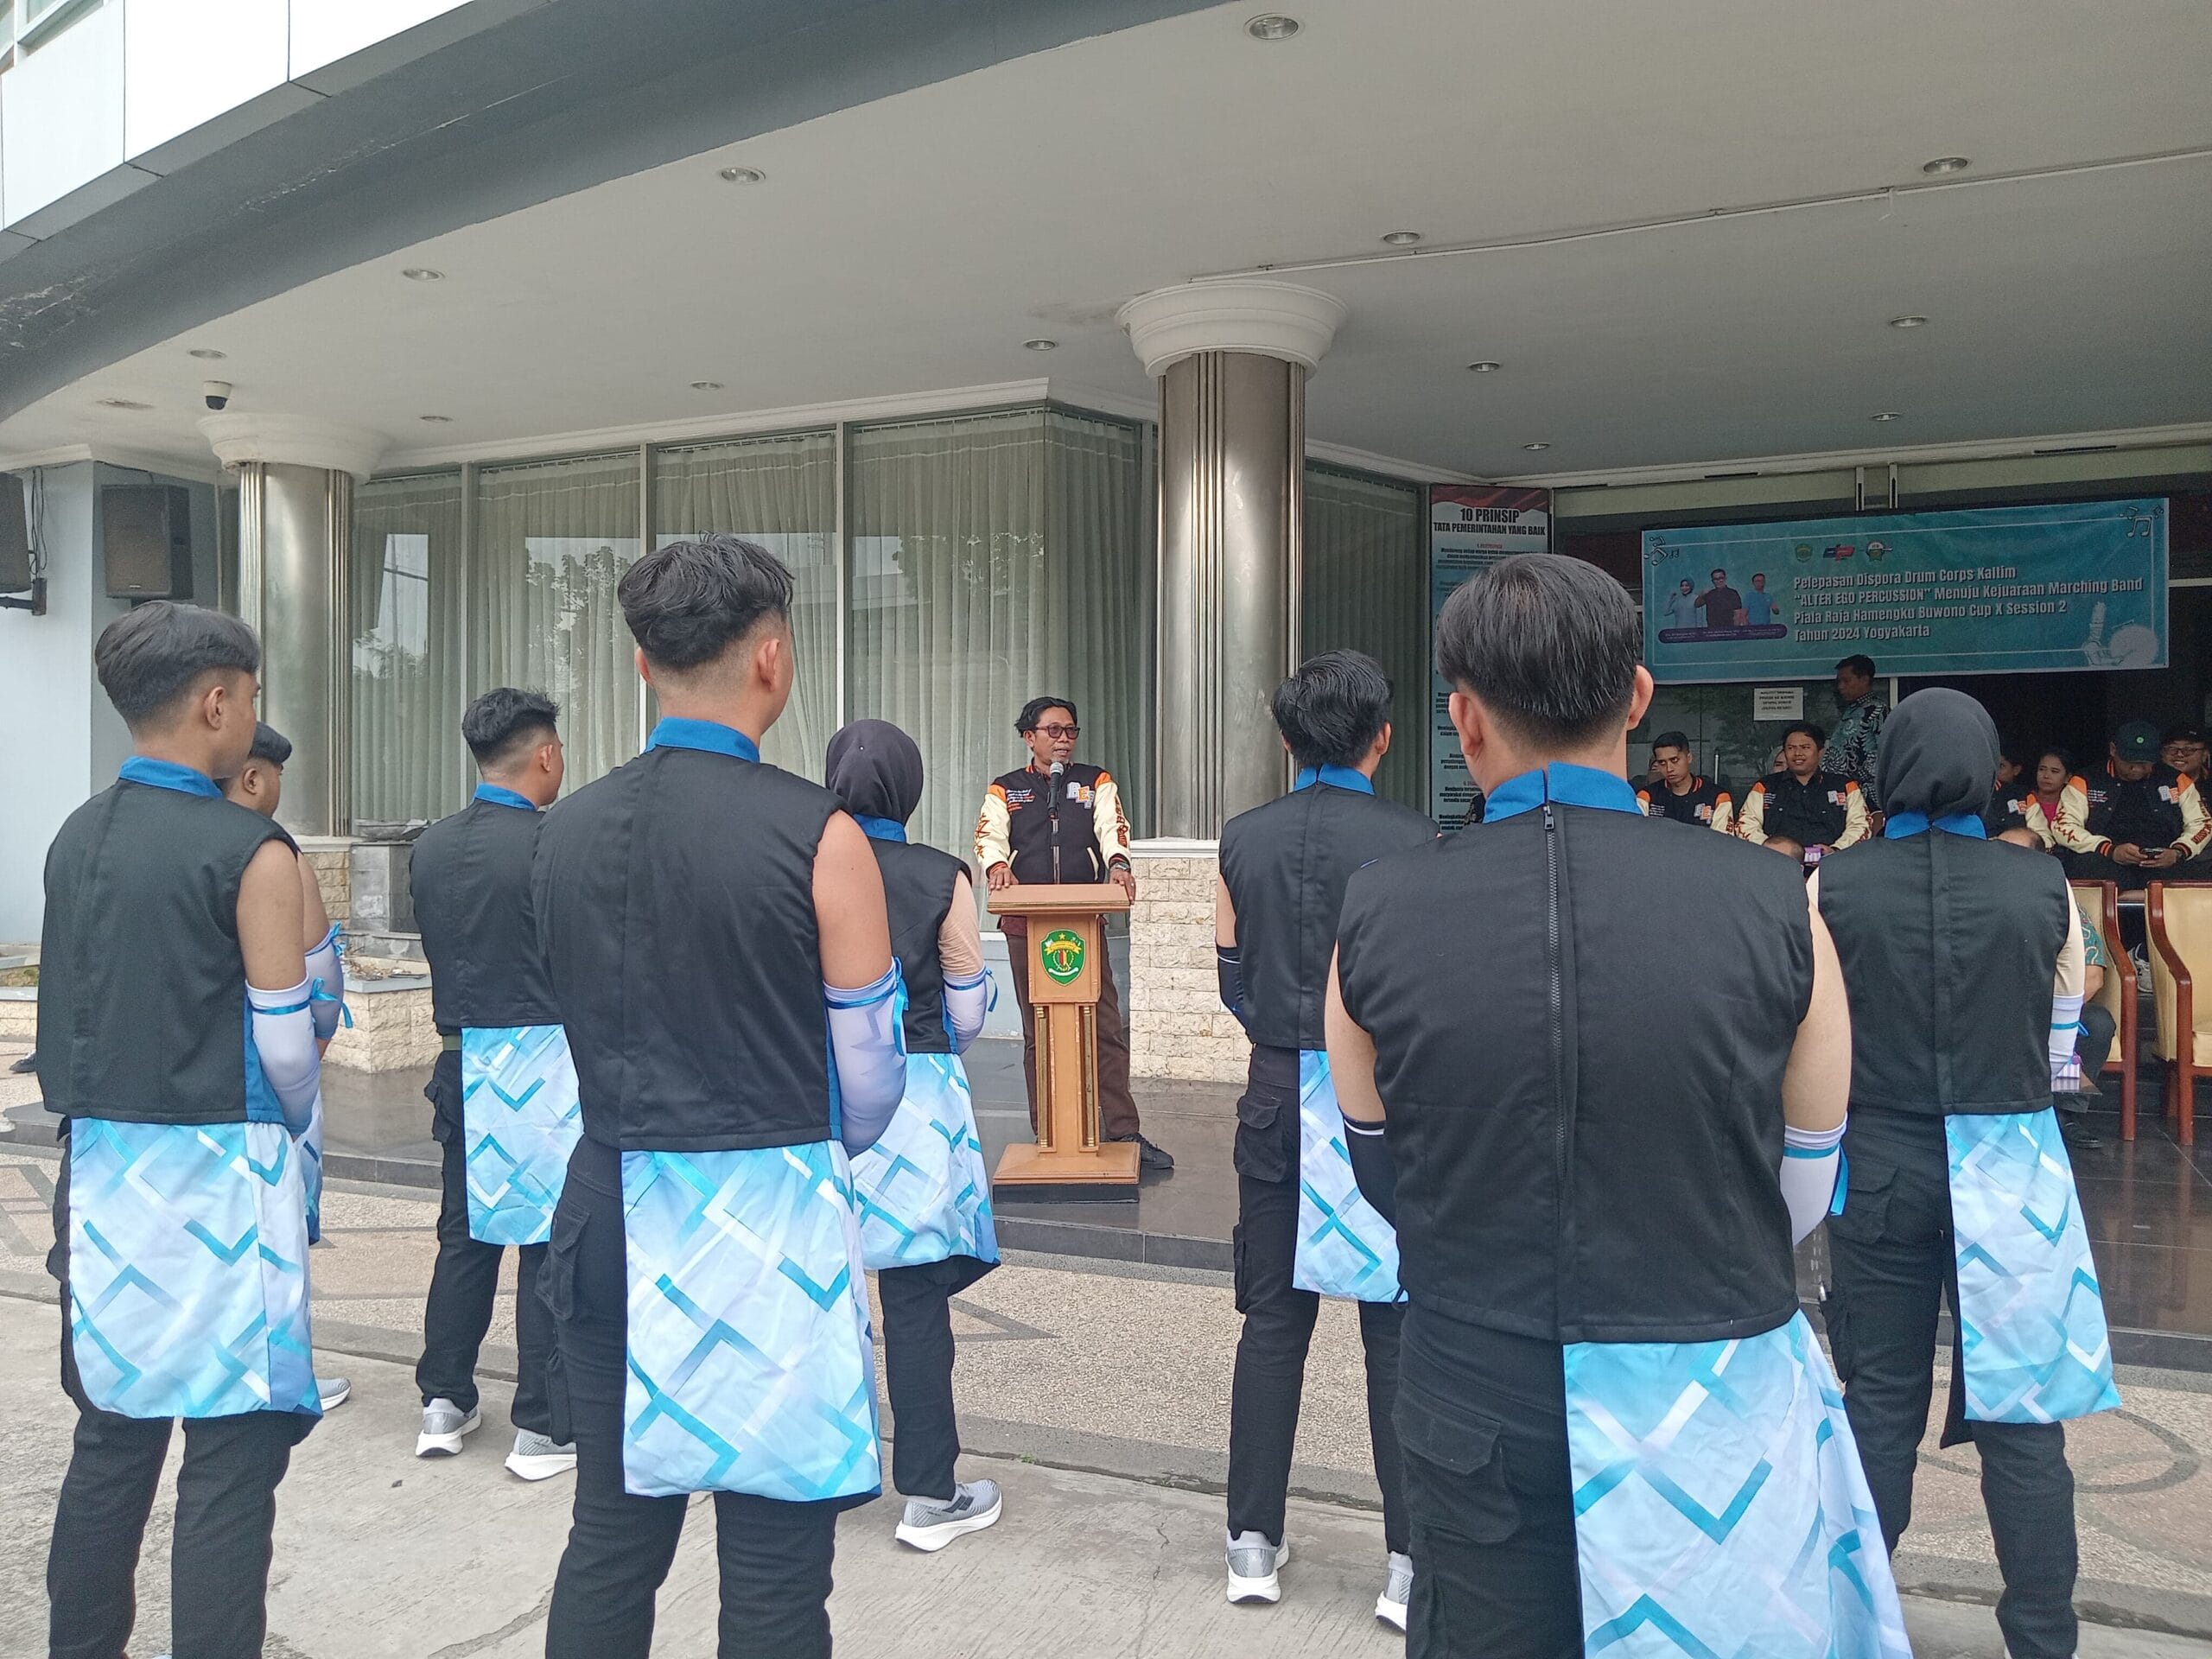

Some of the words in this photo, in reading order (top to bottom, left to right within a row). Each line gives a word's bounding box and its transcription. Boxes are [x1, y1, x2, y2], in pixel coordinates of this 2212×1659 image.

[1460, 508, 1473, 521] 10
[1476, 508, 1519, 524] PRINSIP
[1433, 522, 1451, 532] TATA
[1452, 523, 1507, 534] PEMERINTAHAN
[1508, 524, 1527, 535] YANG
[1528, 525, 1546, 536] BAIK
[1794, 575, 1853, 590] Pelepasan
[1858, 572, 1901, 588] Dispora
[1905, 570, 1936, 584] Drum
[1940, 568, 1974, 582] Corps
[1977, 565, 2017, 580] Kaltim
[1835, 591, 1855, 605] EGO
[1935, 585, 1980, 600] Menuju
[1983, 583, 2045, 598] Kejuaraan
[2049, 580, 2107, 595] Marching
[2112, 577, 2143, 592] Band
[1794, 611, 1822, 625] Piala
[1825, 609, 1850, 624] Raja
[1853, 607, 1916, 622] Hamengku
[1918, 605, 1966, 619] Buwono
[1969, 604, 1993, 618] Cup
[1995, 603, 2003, 616] X
[2006, 600, 2055, 615] Session
[2058, 600, 2067, 613] 2
[1795, 628, 1829, 642] Tahun
[1832, 626, 1860, 640] 2024
[1863, 625, 1930, 640] Yogyakarta
